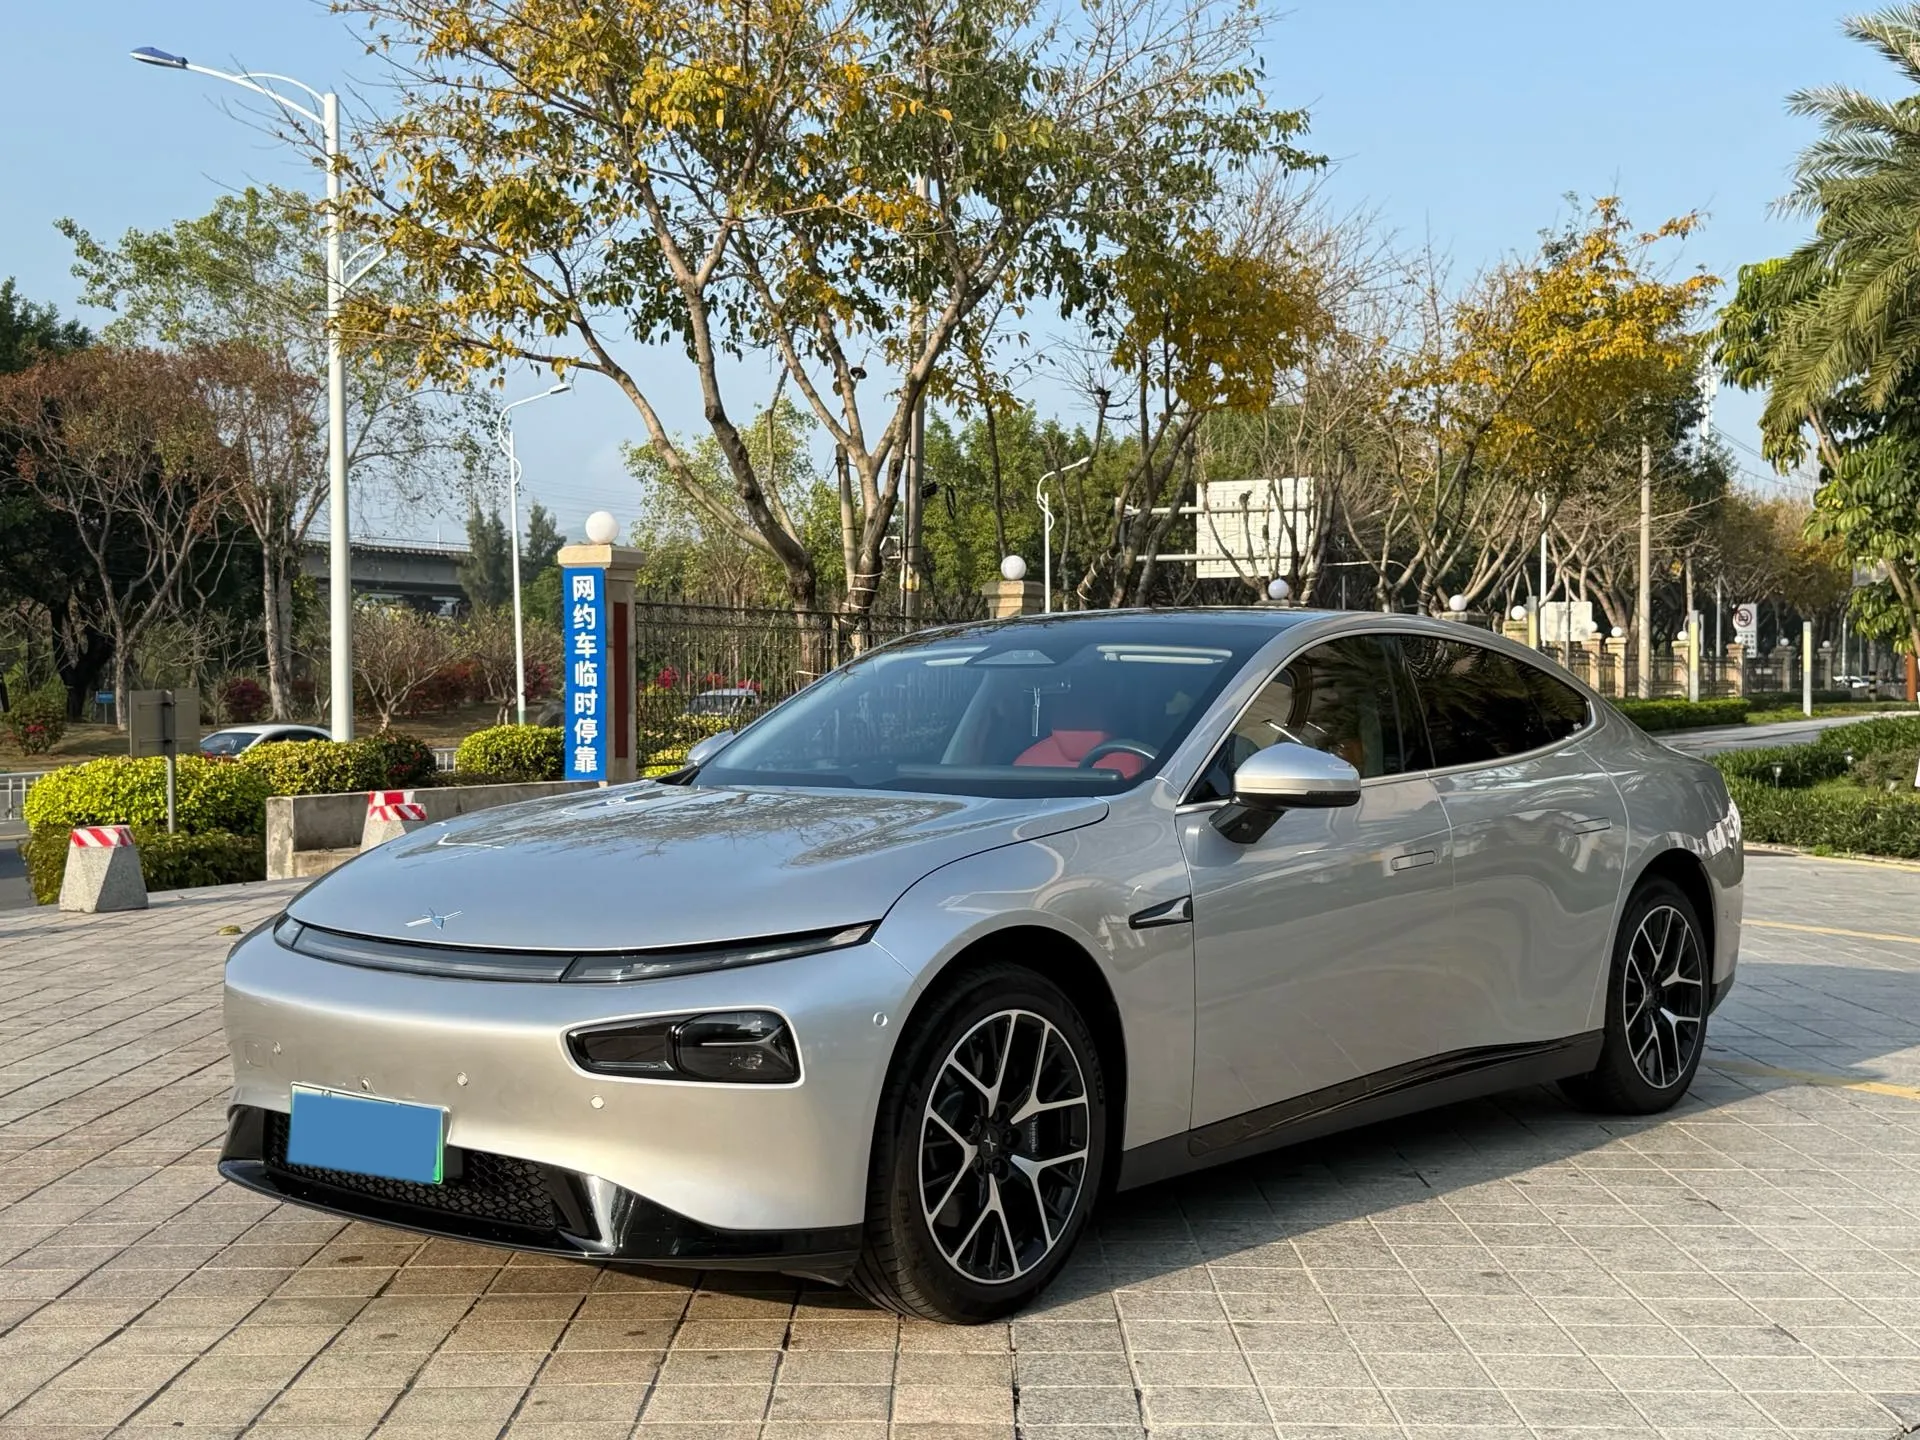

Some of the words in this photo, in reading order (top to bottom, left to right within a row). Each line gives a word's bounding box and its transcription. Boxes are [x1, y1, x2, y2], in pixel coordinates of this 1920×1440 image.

[572, 575, 598, 773] 网约车临时停靠
